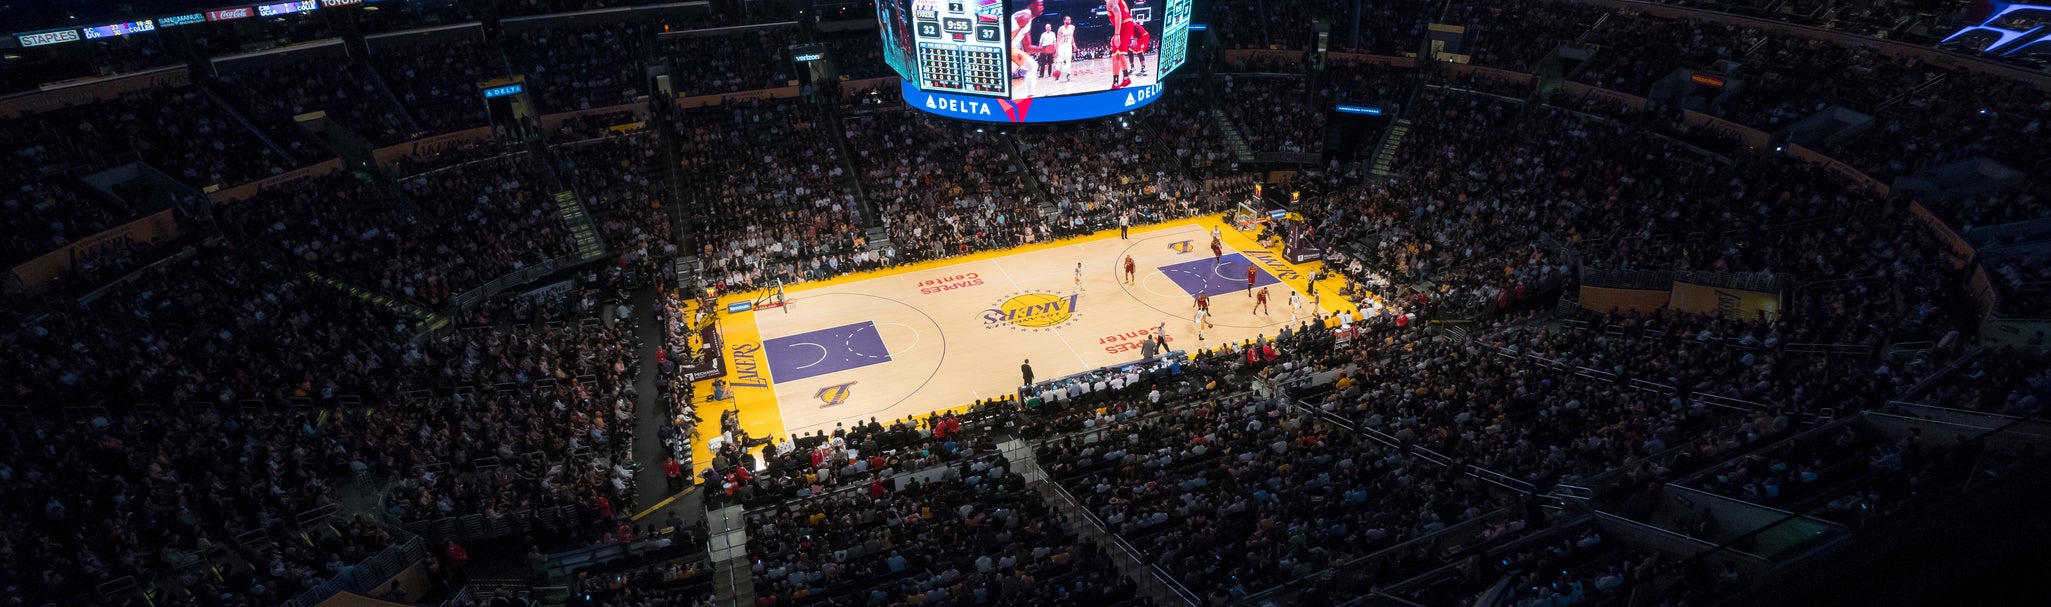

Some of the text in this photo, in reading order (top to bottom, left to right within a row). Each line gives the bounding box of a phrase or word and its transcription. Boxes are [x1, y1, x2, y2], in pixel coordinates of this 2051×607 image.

[923, 26, 935, 34] 32
[947, 20, 968, 30] 9:55
[982, 29, 994, 38] 37
[21, 30, 77, 46] STAPLES
[495, 85, 521, 96] DELTA
[1137, 81, 1162, 102] DELTA
[938, 97, 991, 115] DELTA
[1241, 250, 1305, 280] LAKERS
[918, 272, 979, 288] Center
[920, 278, 985, 296] STAPLES
[975, 293, 1078, 325] LAKERS
[1099, 326, 1159, 345] Center
[1105, 334, 1174, 354] SPLES
[730, 341, 768, 390] LAKERS
